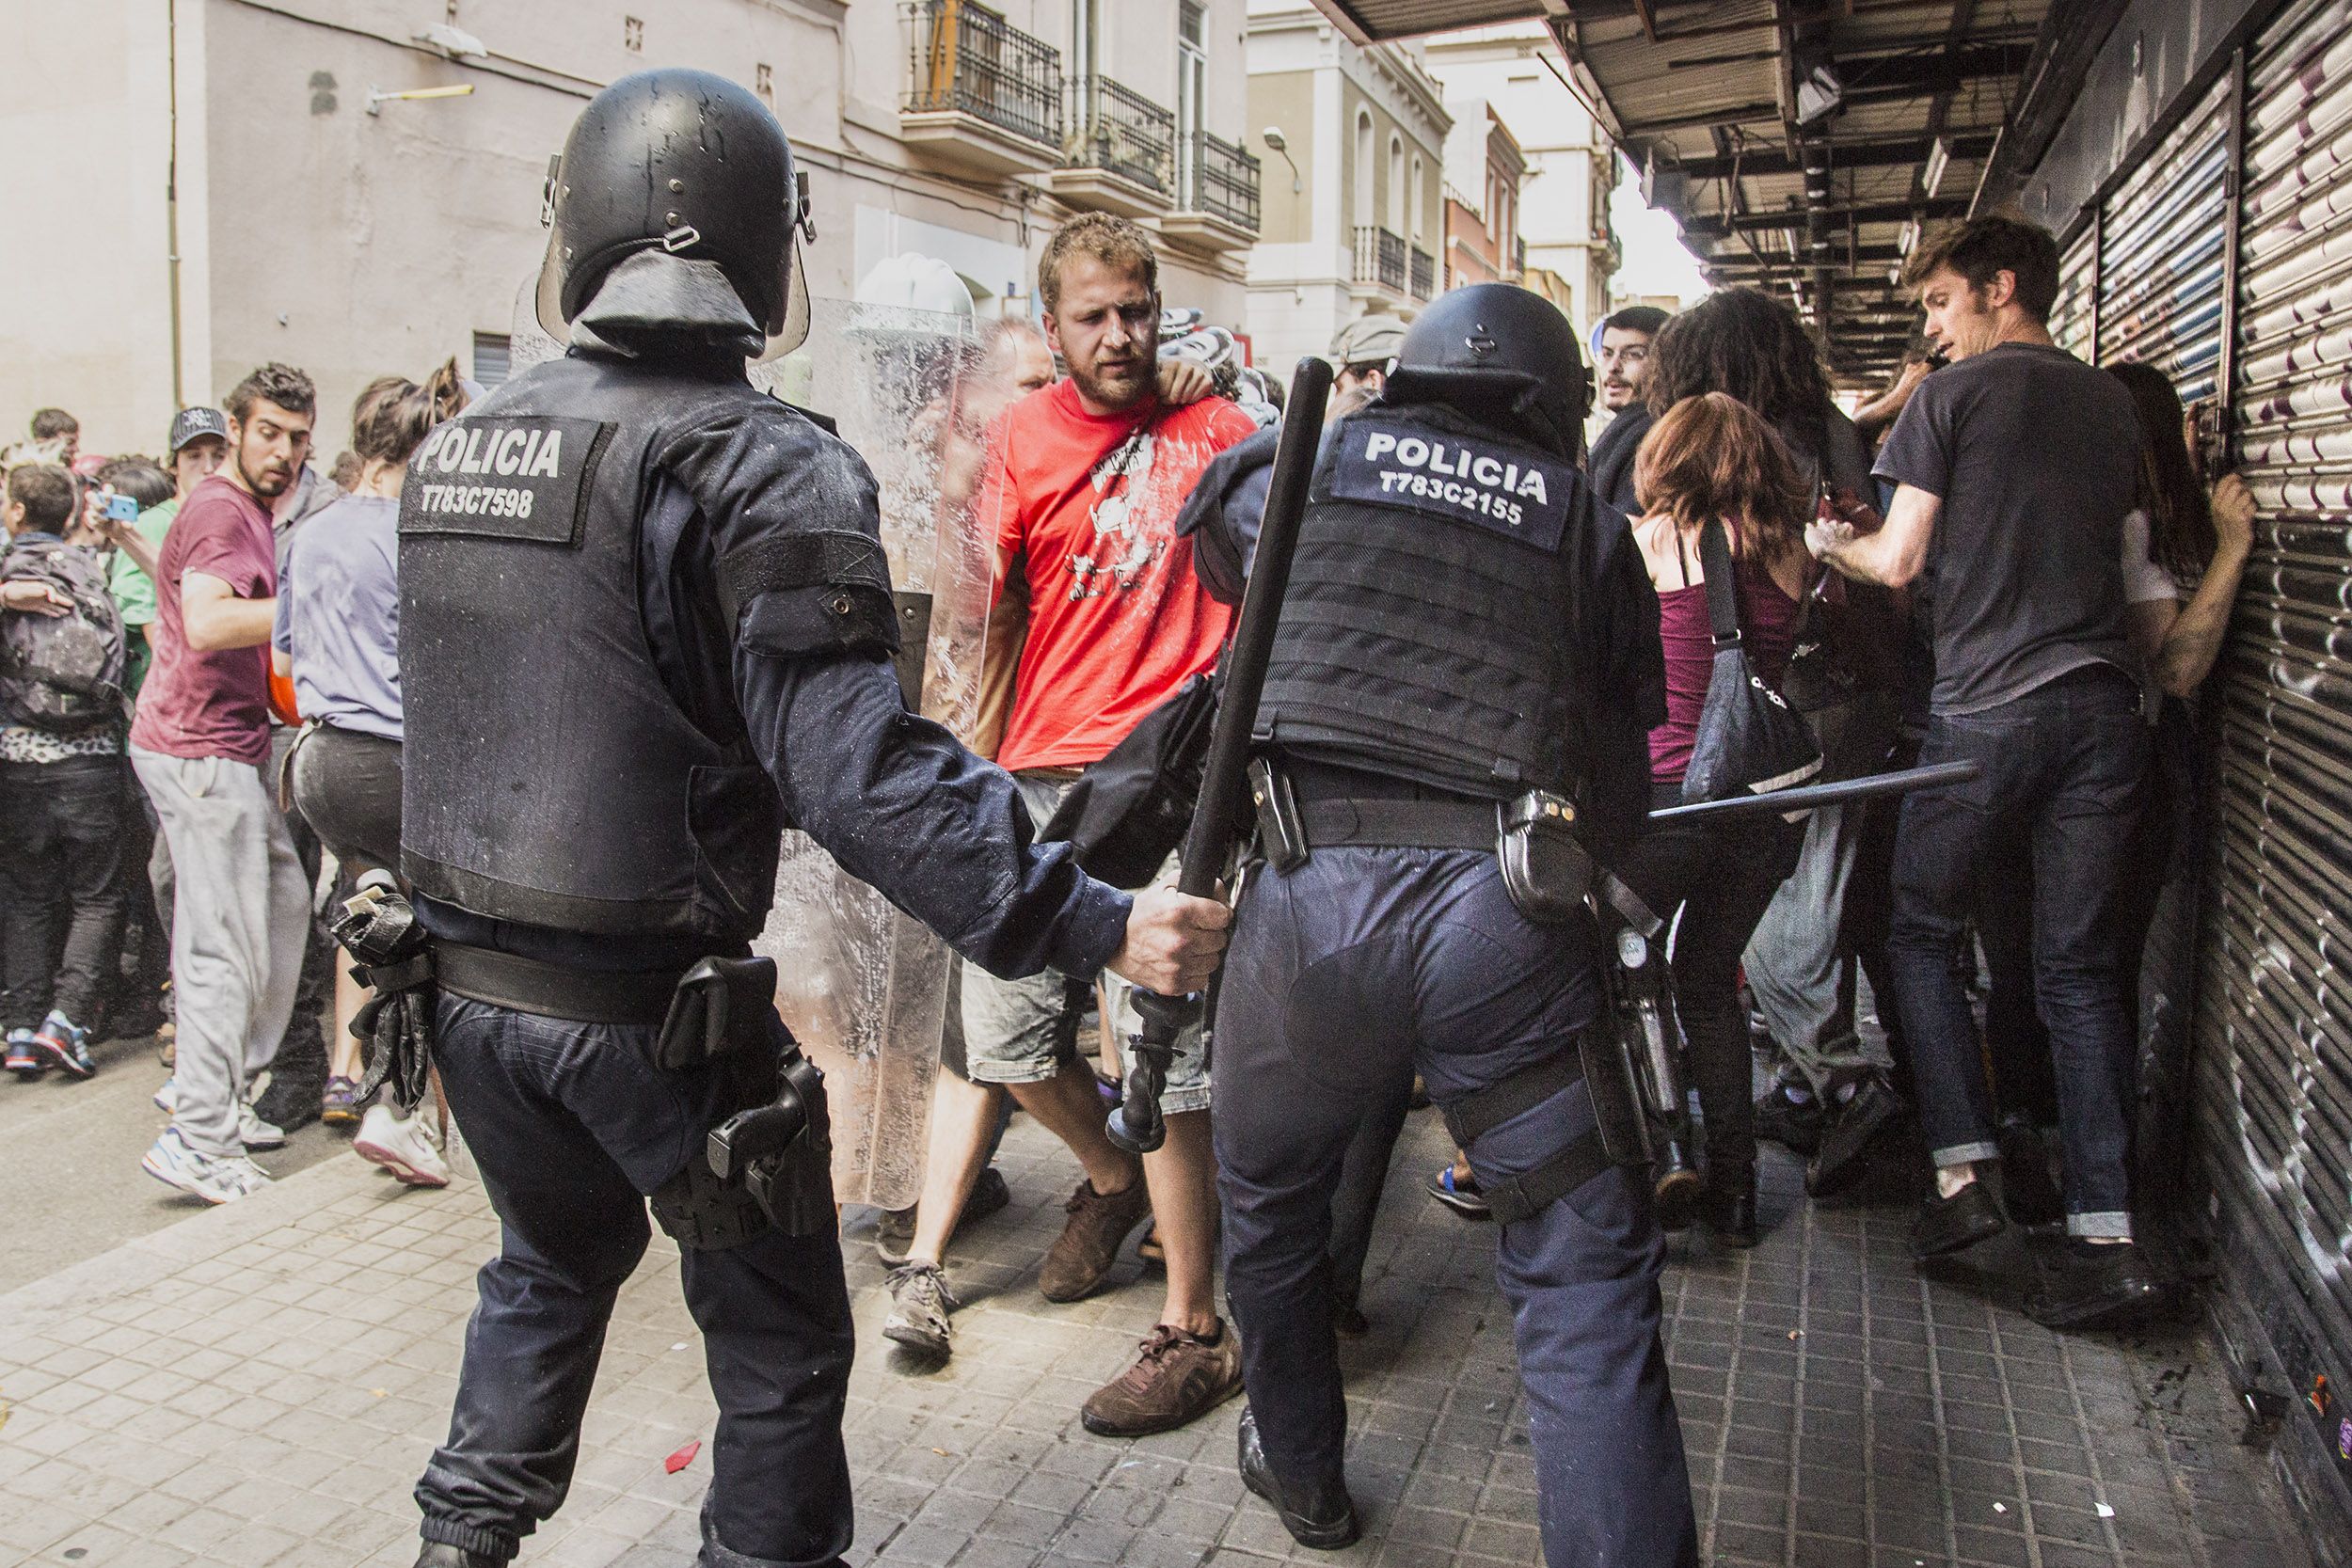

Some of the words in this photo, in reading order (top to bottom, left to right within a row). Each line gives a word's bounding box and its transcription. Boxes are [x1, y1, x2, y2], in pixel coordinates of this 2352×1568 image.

[417, 428, 562, 478] POLICIA
[1365, 432, 1548, 505] POLICIA
[421, 484, 534, 518] T783C7598
[1379, 470, 1523, 526] T783C2155
